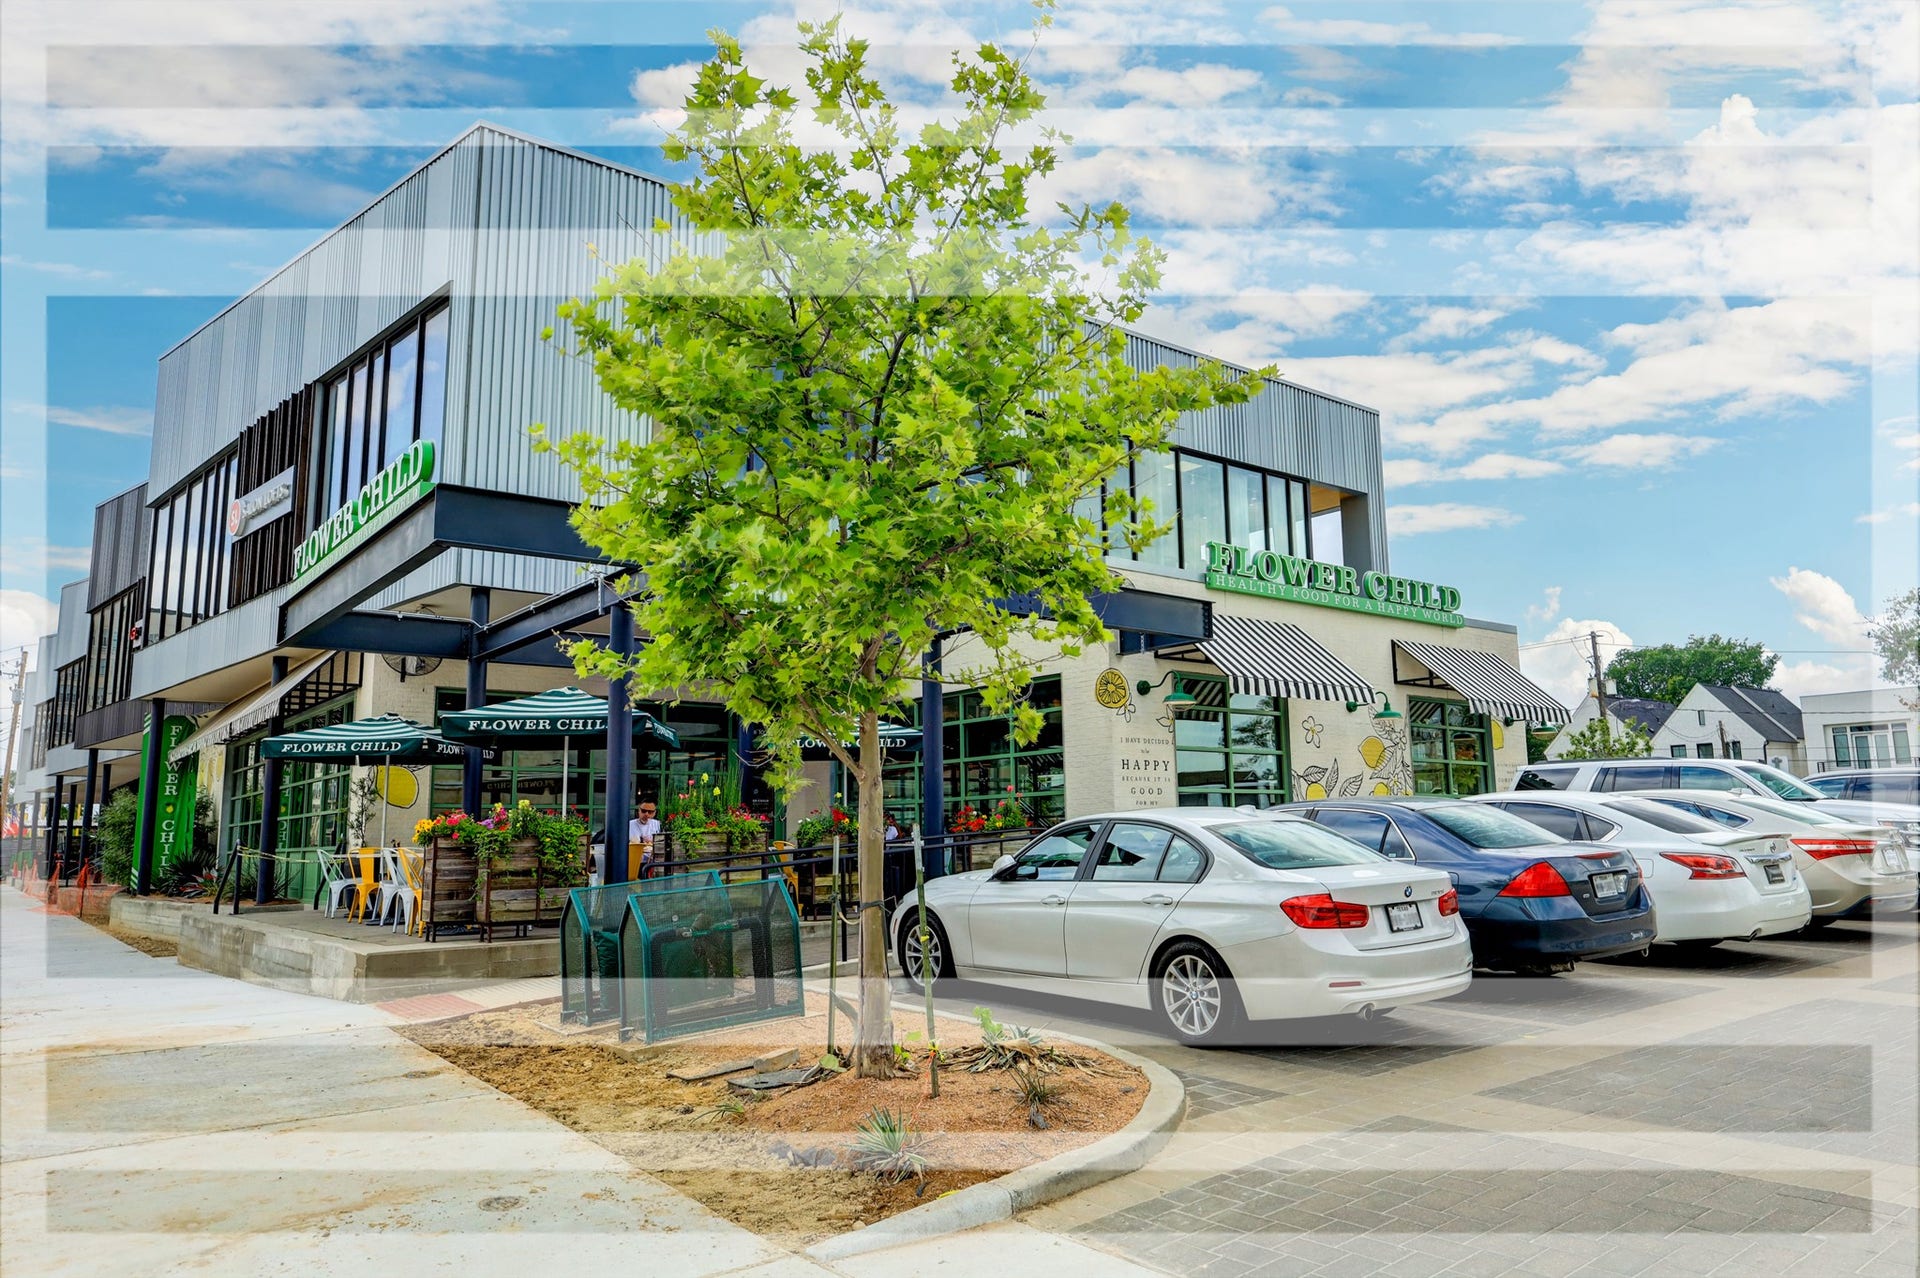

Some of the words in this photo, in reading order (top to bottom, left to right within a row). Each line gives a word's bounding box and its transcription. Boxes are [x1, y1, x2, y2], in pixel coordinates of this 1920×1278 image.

[293, 499, 354, 580] FLOWER
[357, 439, 425, 525] CHILD
[1208, 540, 1360, 596] FLOWER
[1363, 570, 1463, 612] CHILD
[1215, 574, 1286, 597] HEALTHY
[1292, 587, 1329, 603] FOOD
[1334, 594, 1360, 608] FOR
[1364, 600, 1373, 610] A
[1377, 602, 1418, 618] HAPPY
[1422, 609, 1464, 625] WORLD
[467, 718, 552, 732] FLOWER
[556, 718, 609, 731] CHIL
[281, 742, 347, 754] FLOWER
[350, 741, 402, 752] CHILD
[435, 743, 465, 756] FLOWE
[786, 739, 852, 749] LOWR
[163, 725, 183, 796] FLWER
[482, 749, 495, 759] ILD
[1121, 759, 1170, 772] HAPPY
[1130, 786, 1163, 796] GOOD
